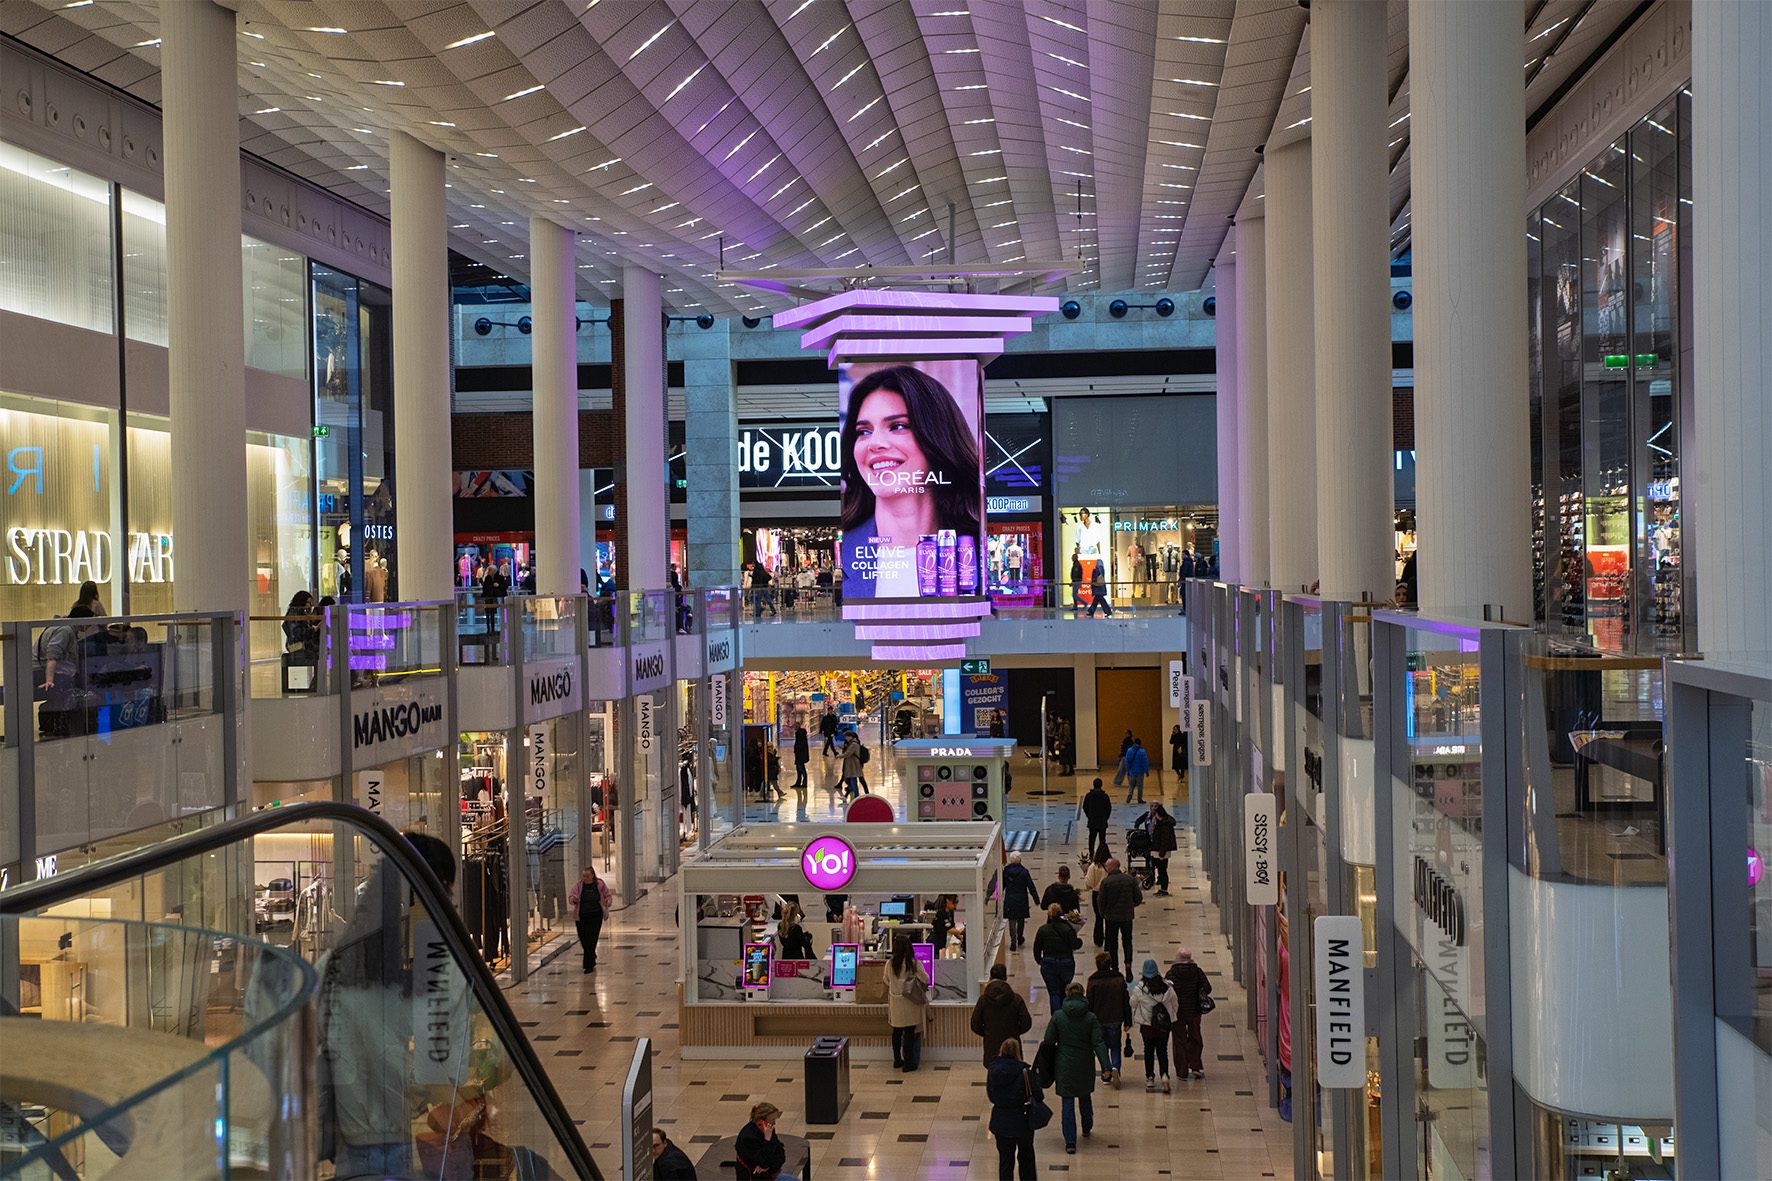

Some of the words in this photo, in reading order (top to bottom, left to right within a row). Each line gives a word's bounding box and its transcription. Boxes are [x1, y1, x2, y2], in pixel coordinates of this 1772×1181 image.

[738, 431, 770, 472] de
[867, 470, 952, 486] L'ORÉAL
[1114, 521, 1178, 531] PRIMARK
[868, 536, 891, 544] NIEUW
[855, 546, 905, 559] ELVIVE
[851, 561, 909, 570] COLLAGEN
[862, 571, 898, 580] LIFTER
[964, 686, 1005, 697] COLLEGA'S
[1172, 670, 1181, 698] Pearle
[715, 680, 723, 721] MANGO
[967, 694, 1003, 705] GEZOCHT
[421, 704, 442, 724] MAN
[641, 701, 650, 750] MANGO
[930, 747, 973, 757] PRADA
[534, 732, 545, 791] MANGO
[806, 849, 850, 875] YO!
[1328, 939, 1352, 1065] MANFIELD
